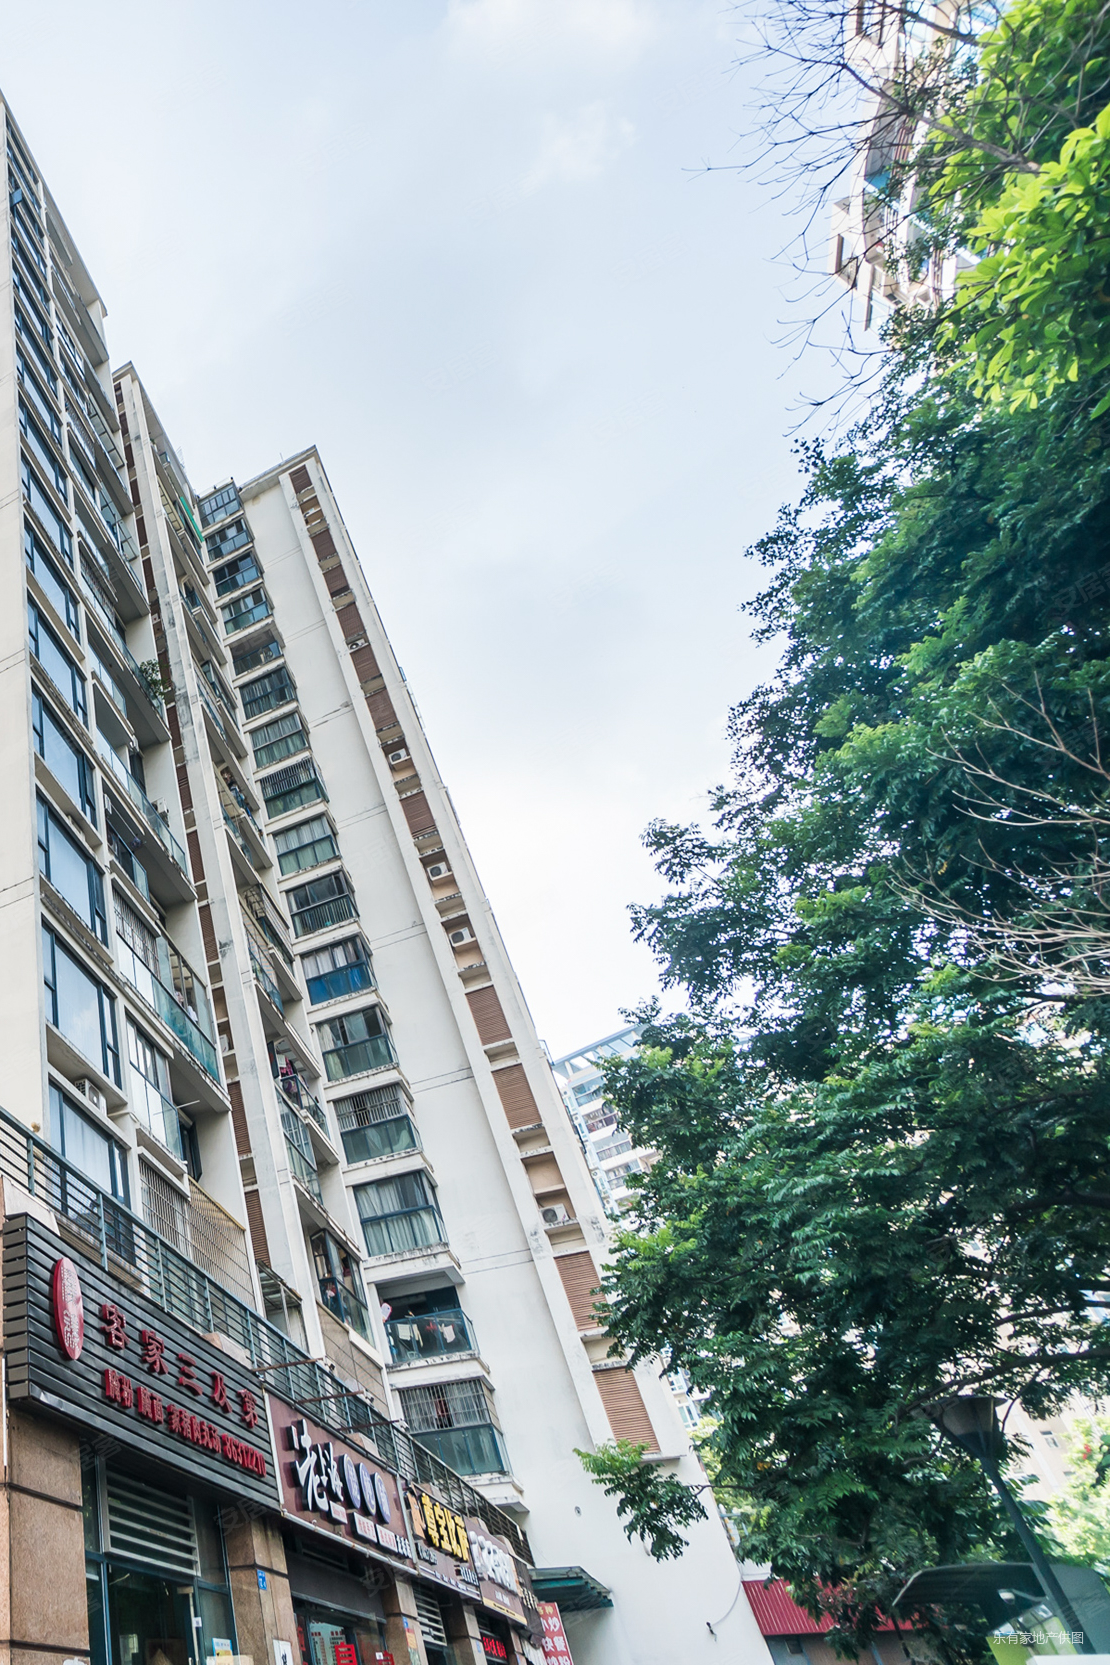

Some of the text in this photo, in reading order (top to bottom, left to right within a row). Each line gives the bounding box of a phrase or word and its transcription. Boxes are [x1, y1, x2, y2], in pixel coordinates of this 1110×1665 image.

[100, 1303, 259, 1429] 客家三及第
